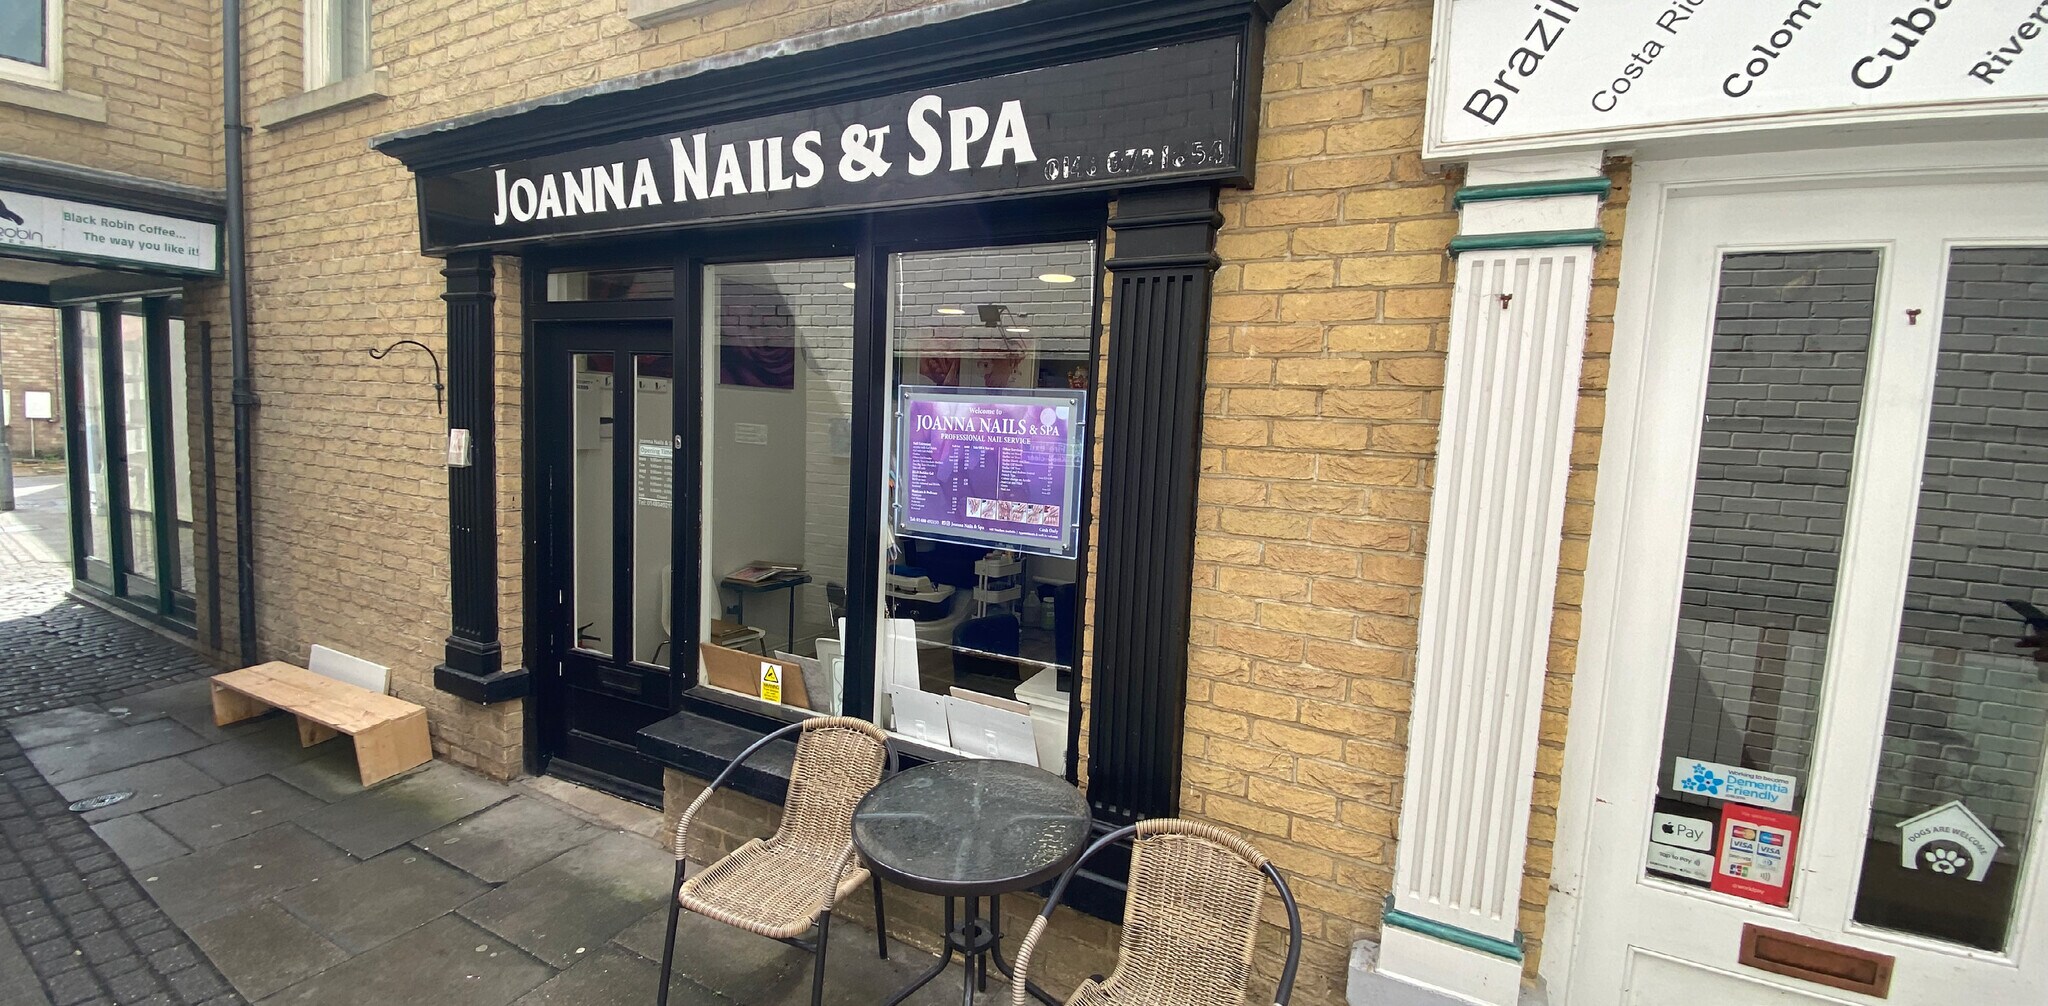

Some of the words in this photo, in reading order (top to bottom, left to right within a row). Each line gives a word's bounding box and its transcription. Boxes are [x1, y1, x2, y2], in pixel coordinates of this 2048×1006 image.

[1462, 0, 1580, 126] Brazil
[1592, 40, 1665, 112] Costa
[493, 157, 663, 226] JOANNA
[669, 130, 825, 203] NAILS
[837, 123, 893, 182] &
[906, 94, 1038, 176] SPA
[63, 211, 97, 226] Black
[100, 217, 135, 231] Robin
[138, 223, 186, 239] Coffee...
[83, 231, 106, 243] The
[110, 237, 135, 249] way
[138, 241, 160, 251] you
[164, 242, 185, 255] like
[188, 246, 200, 257] it!
[969, 406, 995, 415] Welcome
[915, 414, 975, 432] JOANNA
[980, 417, 1027, 435] NAILS
[1029, 425, 1038, 435] &
[1039, 425, 1060, 436] SPA
[940, 433, 985, 442] PROFESSIONAL
[987, 435, 1002, 443] NAIL
[1003, 436, 1031, 445] SERVICE
[640, 446, 660, 454] Opening
[1727, 769, 1755, 780] Working
[1763, 775, 1789, 785] become
[1727, 775, 1789, 794] Dementia
[1725, 785, 1779, 803] Friendly
[1677, 823, 1704, 842] Pay
[1908, 826, 1932, 843] DOGS
[1952, 828, 1988, 856] WELCOME
[1733, 840, 1753, 849] VISA
[1761, 845, 1781, 855] VISA
